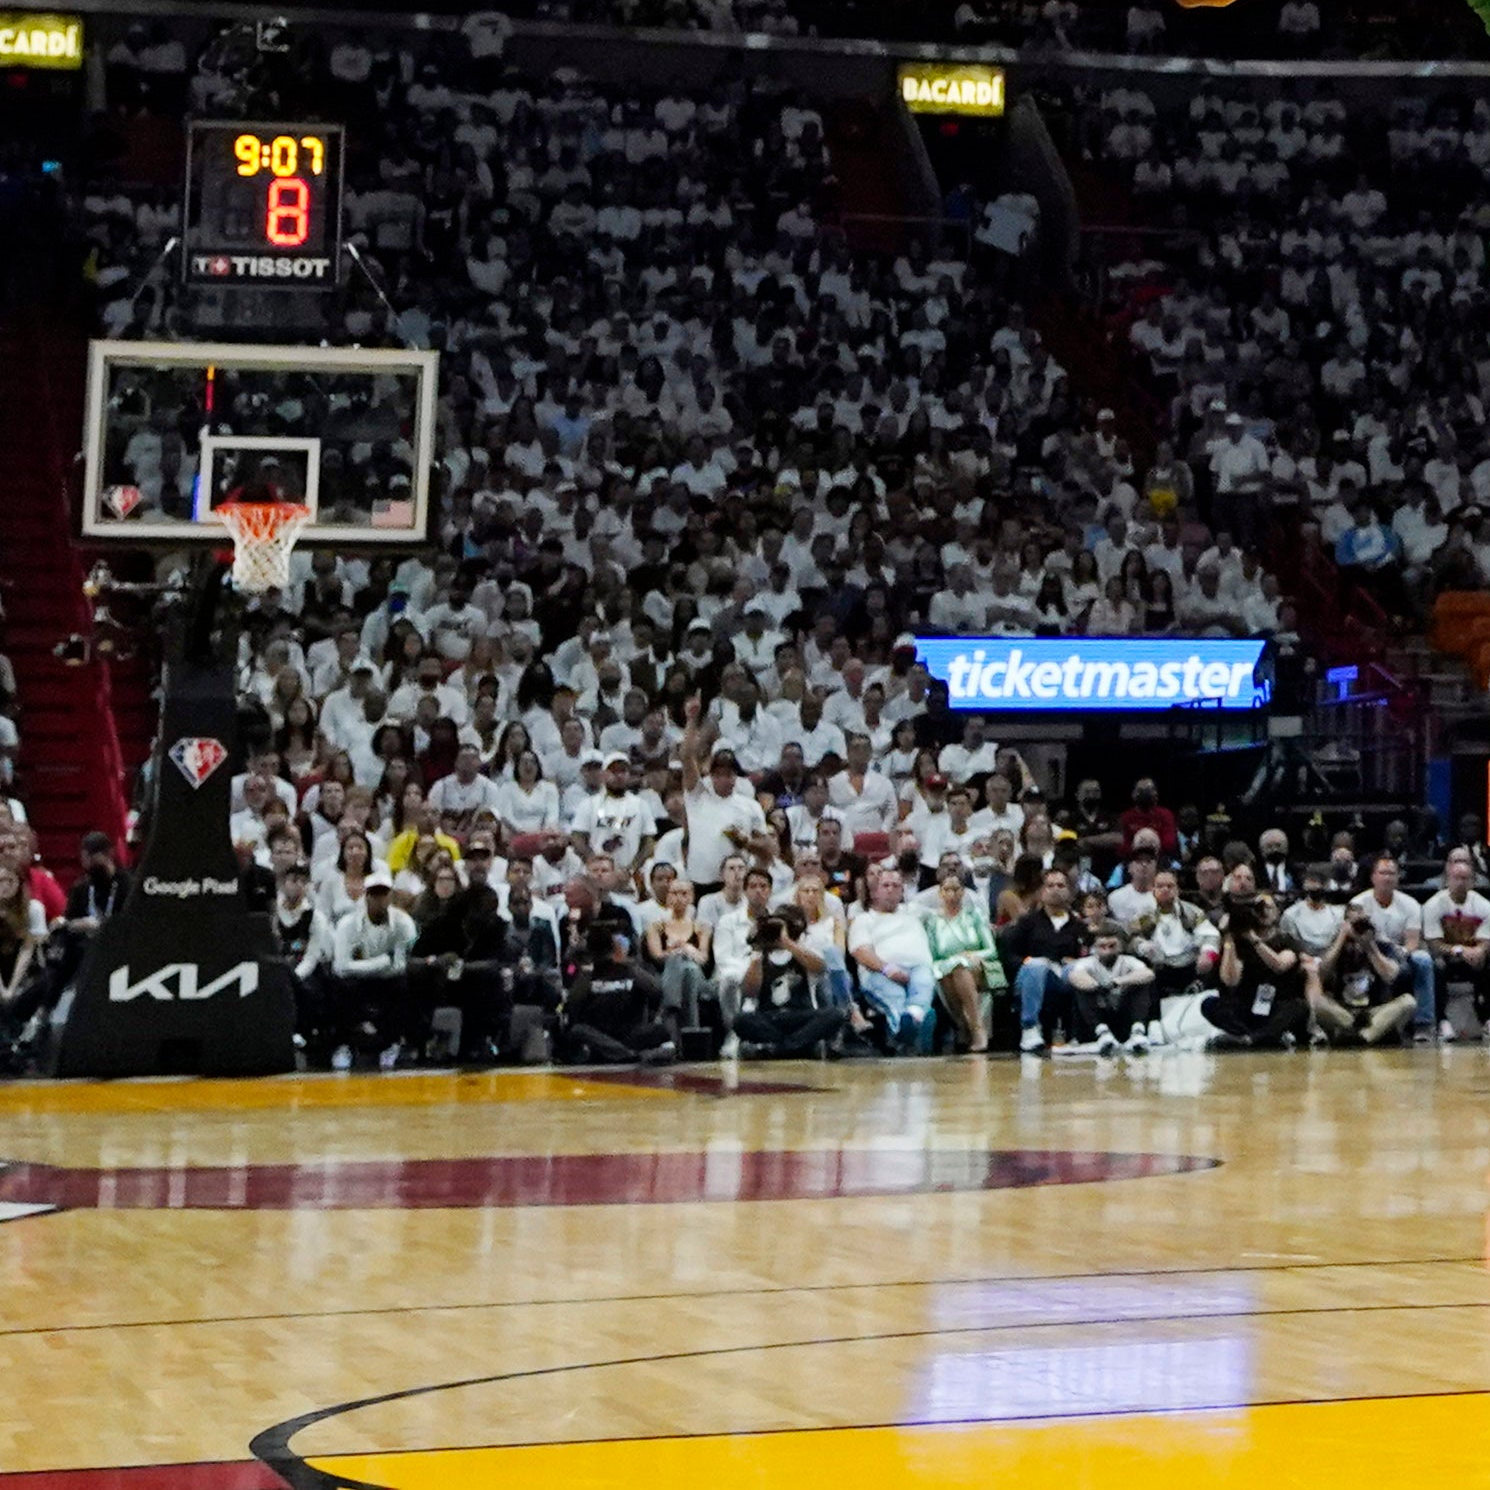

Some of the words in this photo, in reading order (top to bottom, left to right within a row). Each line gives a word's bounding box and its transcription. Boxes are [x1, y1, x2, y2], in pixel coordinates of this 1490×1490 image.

[234, 133, 325, 177] 9:07
[265, 176, 311, 248] 8
[230, 256, 331, 279] TISSOT
[947, 648, 1255, 699] ticketmaster
